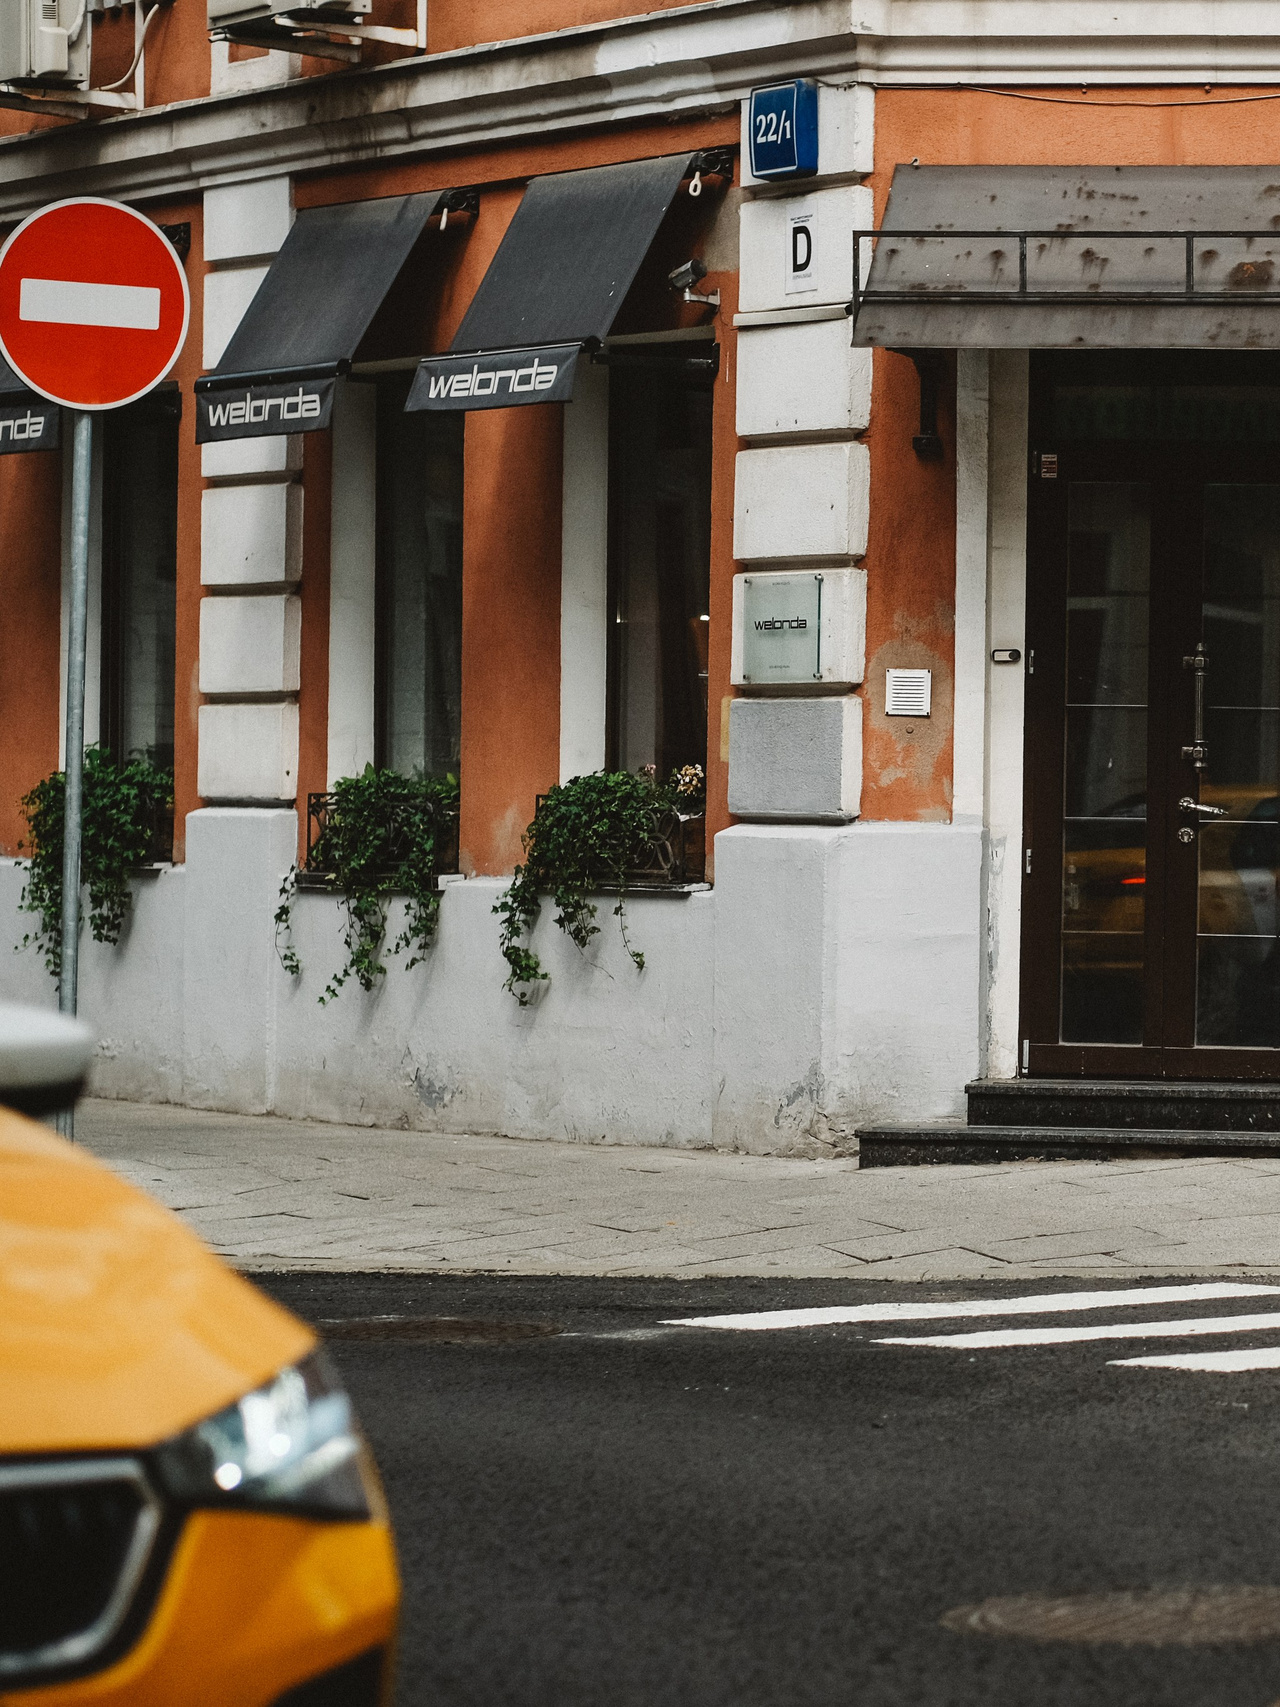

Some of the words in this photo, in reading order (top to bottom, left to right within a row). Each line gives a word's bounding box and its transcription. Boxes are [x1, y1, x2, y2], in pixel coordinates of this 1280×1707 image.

[756, 109, 791, 144] 22/1
[792, 225, 812, 273] D
[428, 357, 558, 399] welonda
[208, 386, 321, 427] welonda
[754, 616, 807, 631] welonda
